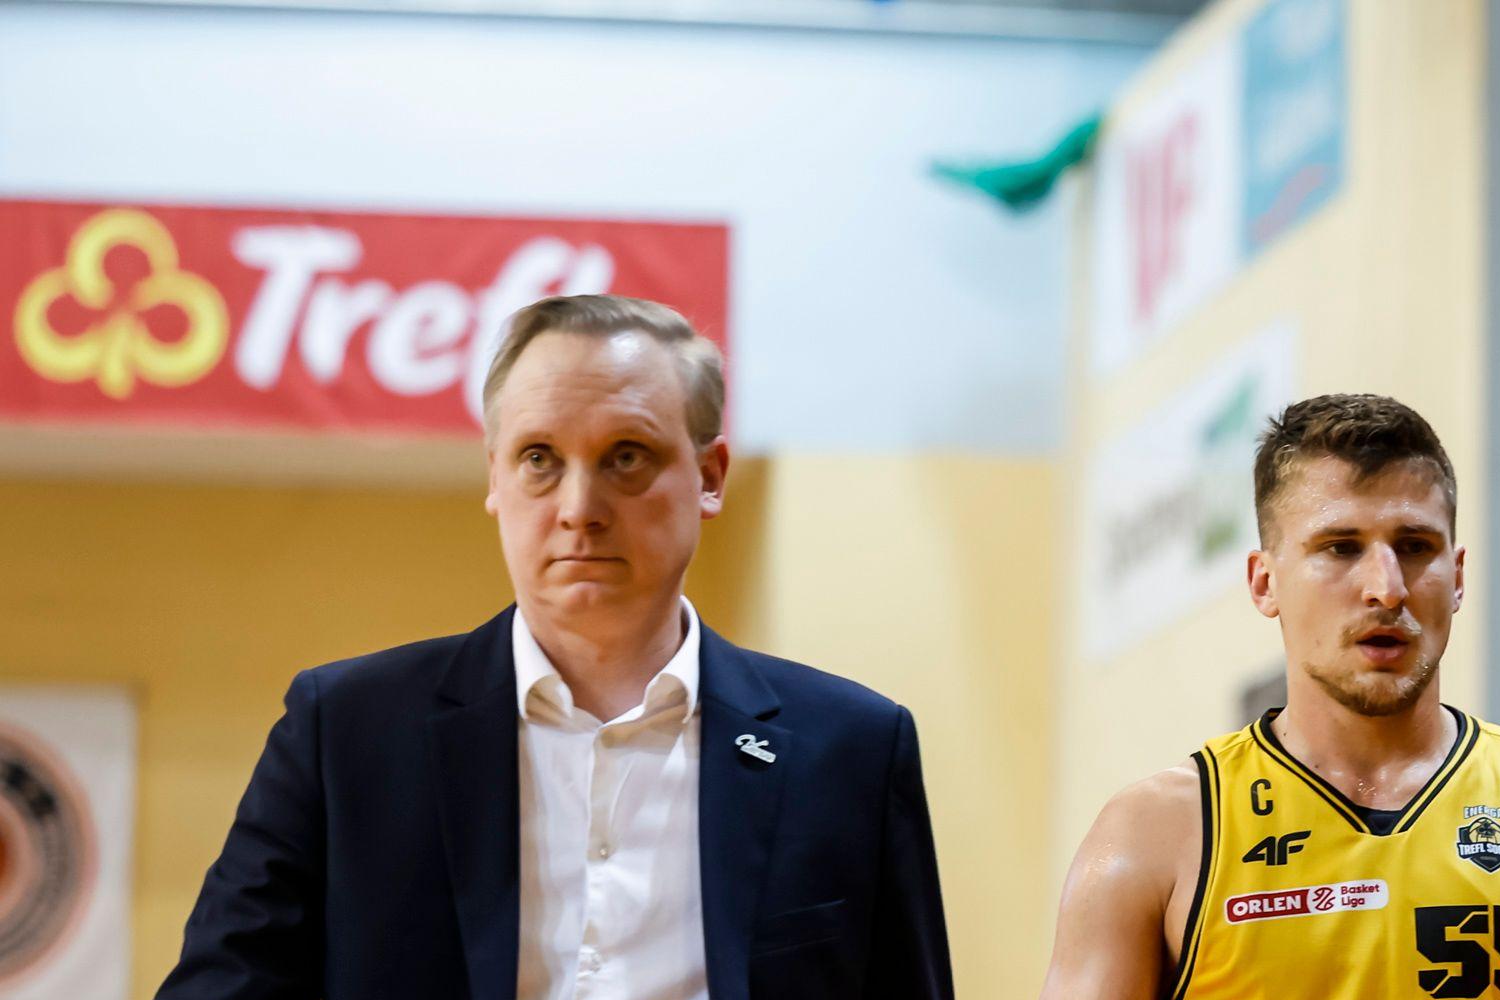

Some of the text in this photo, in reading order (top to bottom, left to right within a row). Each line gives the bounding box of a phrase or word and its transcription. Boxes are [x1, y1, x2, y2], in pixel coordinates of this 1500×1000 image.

[1250, 778, 1274, 816] C
[1242, 830, 1312, 866] 4F
[1459, 843, 1485, 856] TREFL
[1340, 883, 1380, 895] Basket
[1232, 895, 1301, 917] ORLEN
[1341, 895, 1365, 908] Liga
